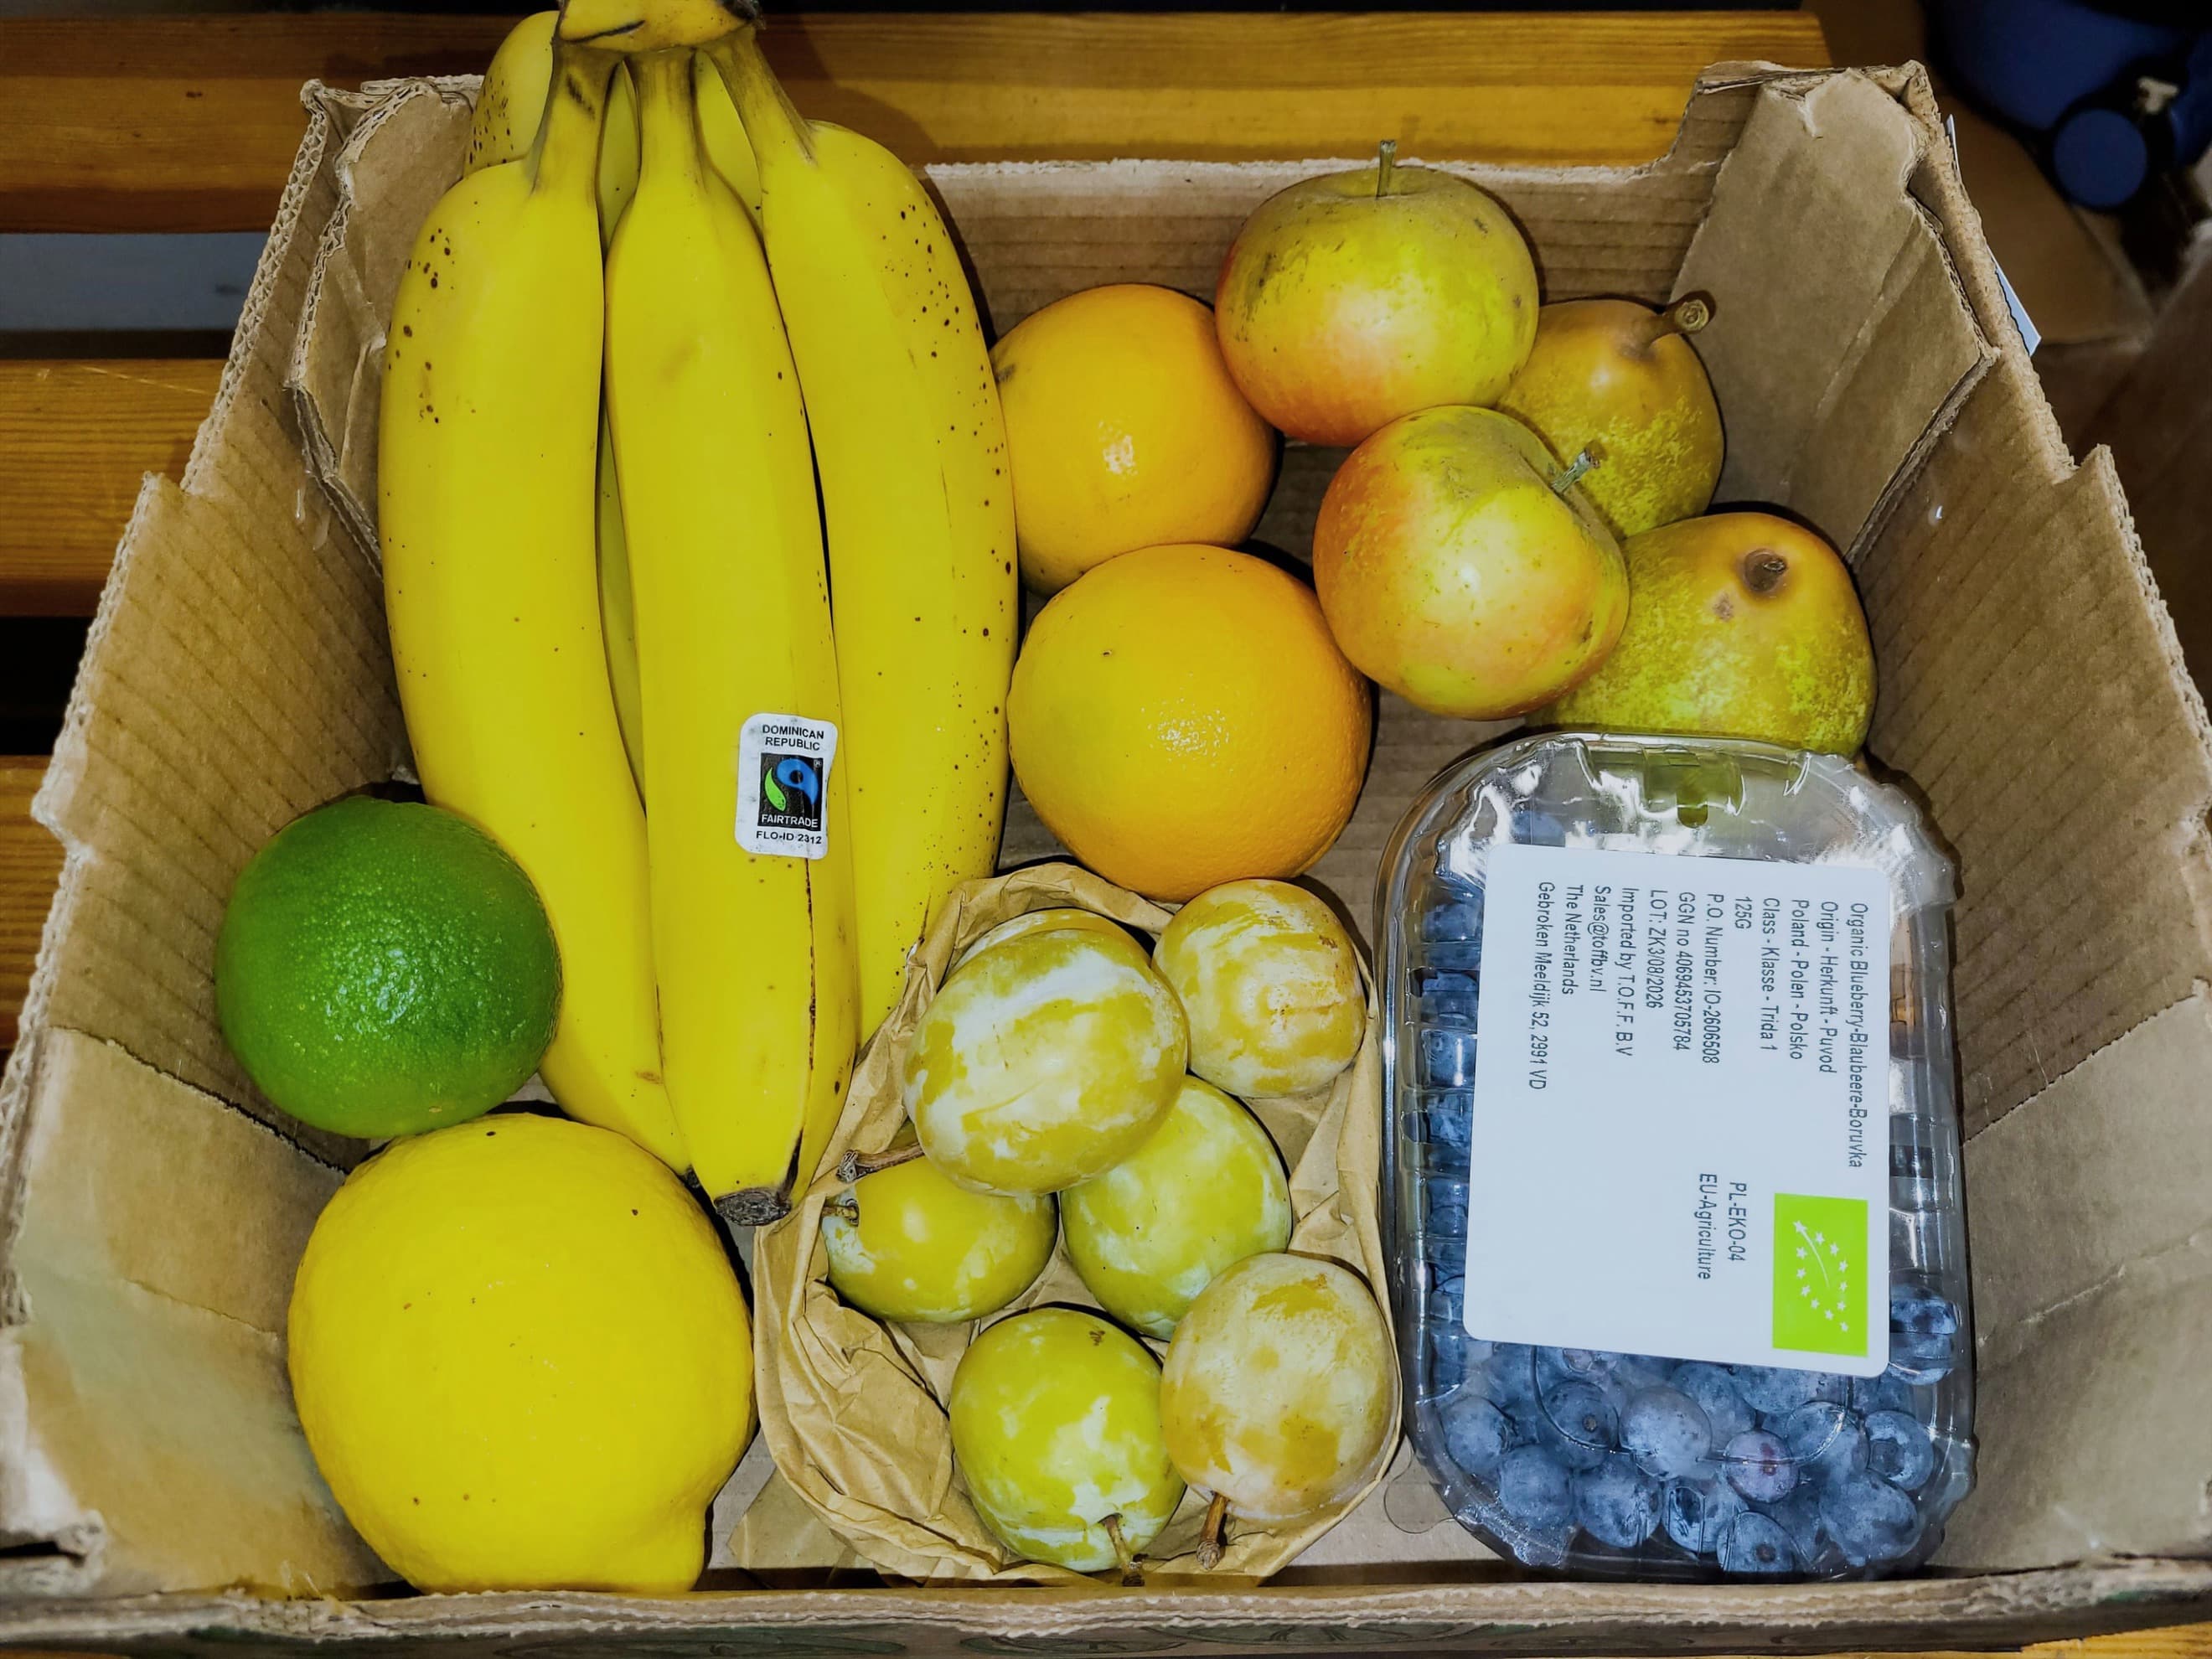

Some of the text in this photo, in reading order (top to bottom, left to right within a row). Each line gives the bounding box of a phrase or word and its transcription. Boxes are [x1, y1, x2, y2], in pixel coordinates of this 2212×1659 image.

[762, 725, 824, 739] DOMINICAN
[765, 736, 819, 751] REPUBLIC
[756, 831, 822, 844] FLO-ID 2312
[762, 814, 818, 828] FAIRTRADE
[1734, 897, 1753, 929] 125G
[1762, 898, 1780, 934] Class
[1791, 900, 1810, 948] Poland
[1816, 902, 1839, 942] Origin
[1562, 885, 1584, 995] The Netherlands
[1587, 886, 1611, 992] Sales@toffbv.nl
[1646, 890, 1667, 1008] LOT: ZK3/08/2026
[1528, 881, 1555, 1089] Gebroken Meeldijk 52, 2991 VD
[1614, 887, 1640, 1056] Imported by T.O.F.F. B.V
[1672, 892, 1696, 1051] GGN no 4069453705784
[1702, 894, 1724, 1063] P.O. Number: IO-2606508
[1761, 947, 1780, 992] Klasse
[1790, 960, 1809, 999] Polen
[1820, 956, 1838, 1015] Herkunft
[1760, 1005, 1779, 1039] Trida
[1790, 1012, 1809, 1060] Polsko
[1845, 903, 1868, 1167] Organic Blueberry-Blaubeere-Boruvka
[1819, 1027, 1838, 1073] Puvod
[1693, 1173, 1718, 1279] EU-Agriculture
[1728, 1182, 1747, 1261] PL-EKO-04
